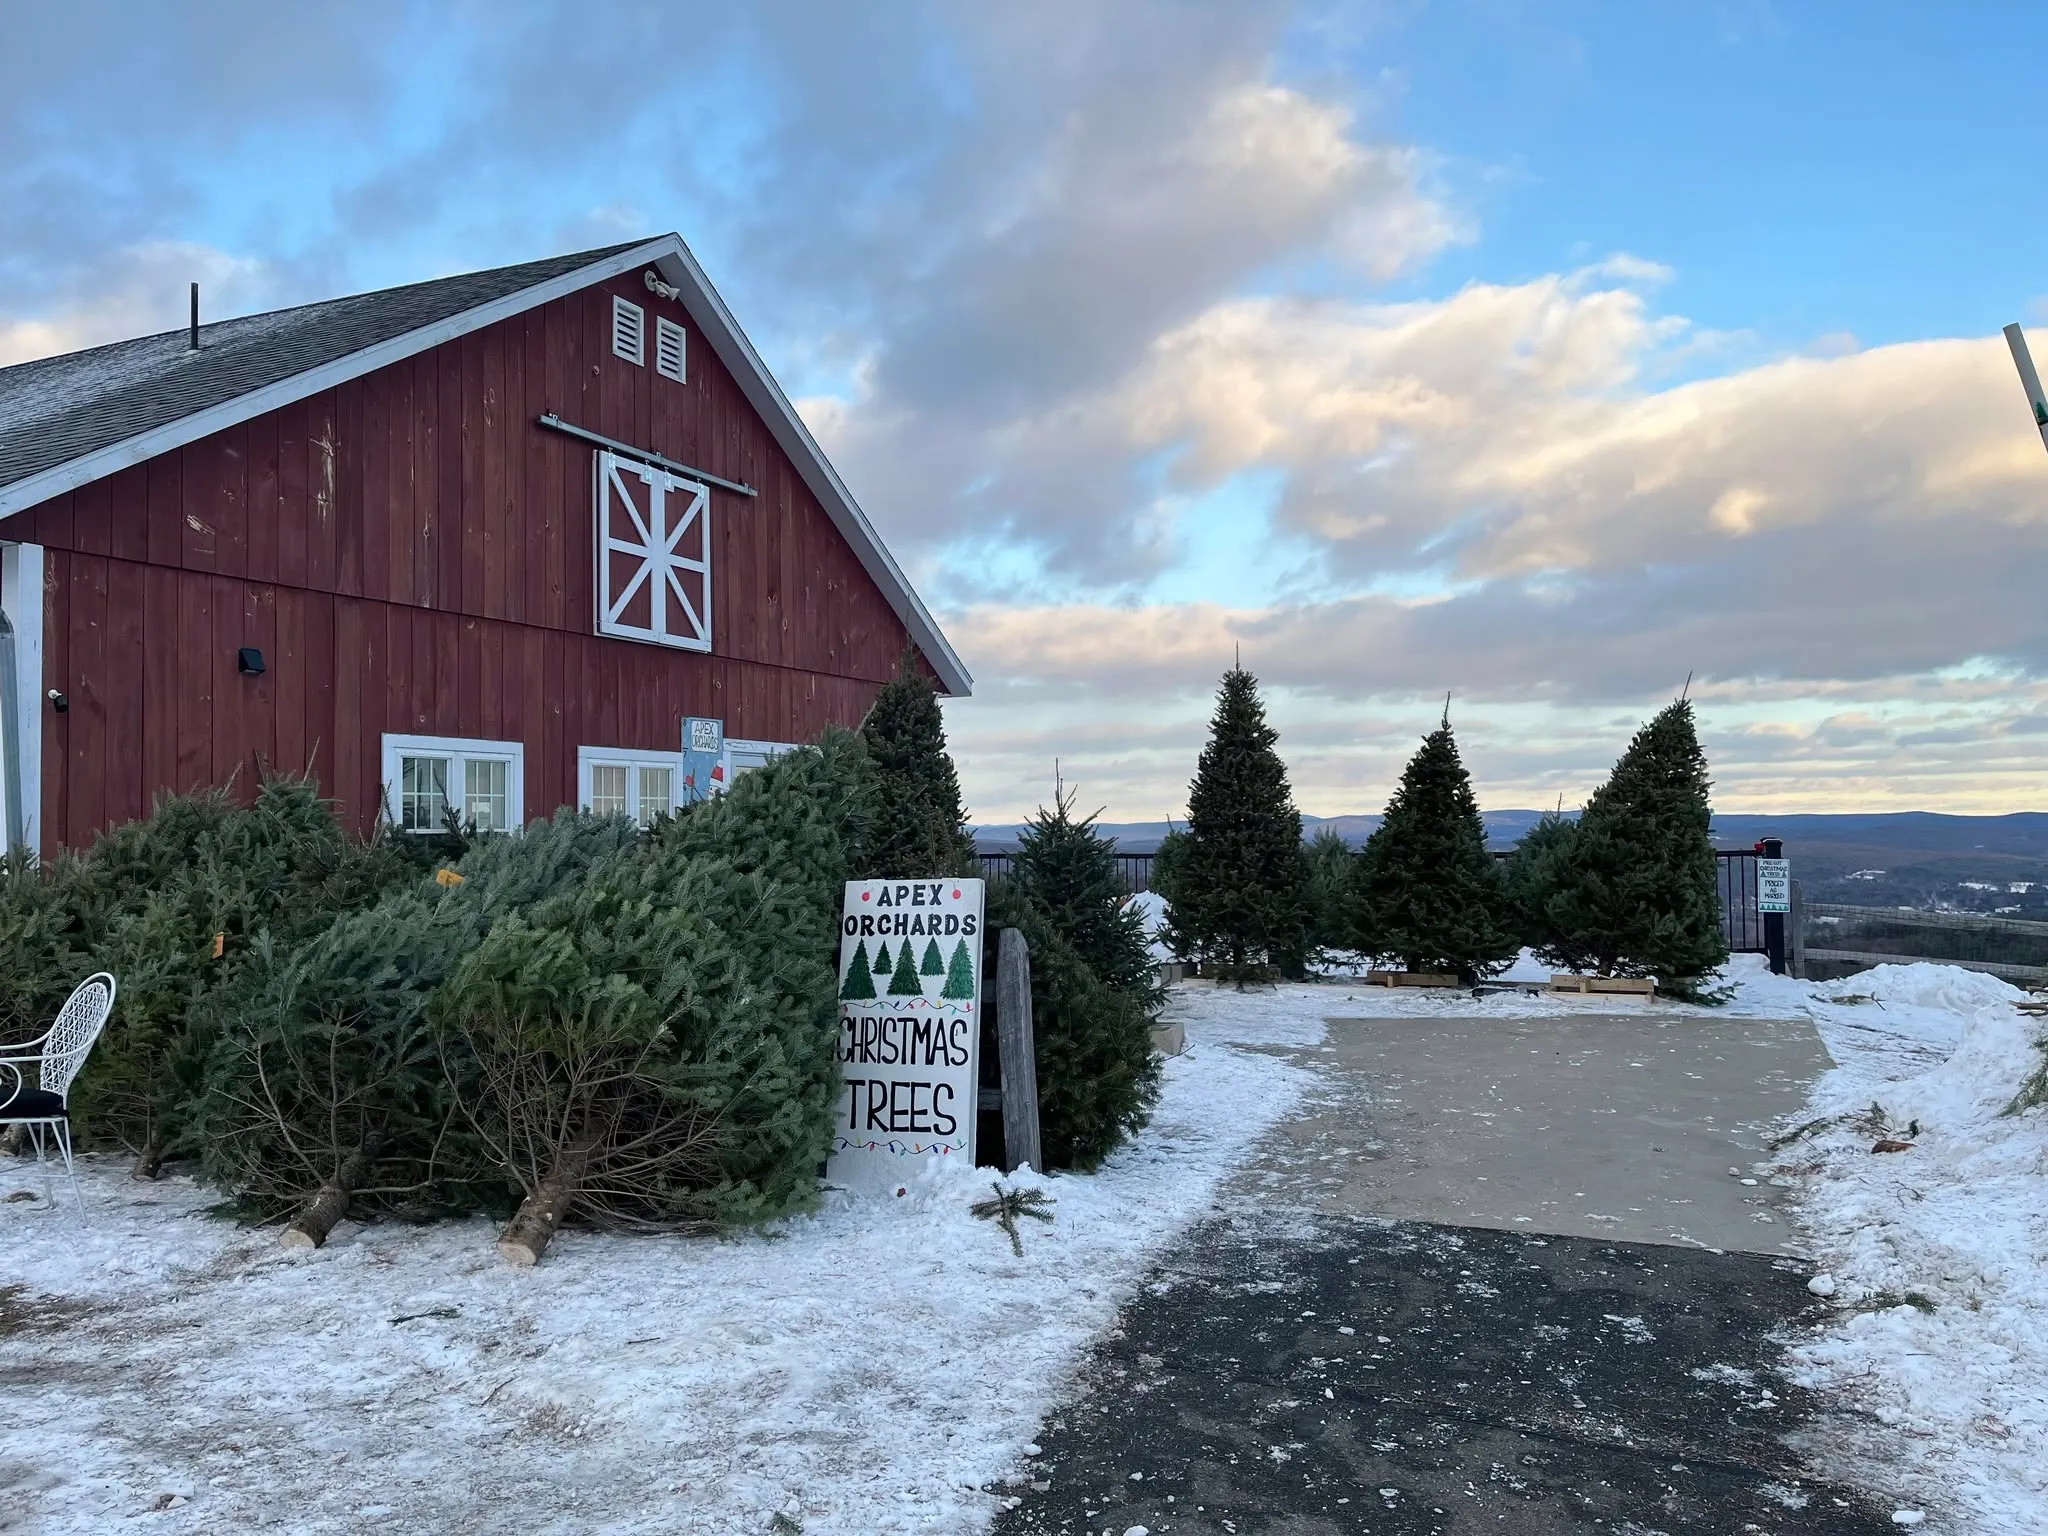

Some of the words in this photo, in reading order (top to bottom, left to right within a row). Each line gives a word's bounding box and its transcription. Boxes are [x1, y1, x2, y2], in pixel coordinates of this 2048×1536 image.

[694, 722, 714, 735] APEX
[877, 884, 944, 907] APEX
[844, 913, 977, 937] ORCHARDS
[837, 1016, 969, 1067] CHRISTMAS
[846, 1079, 957, 1136] TREES
